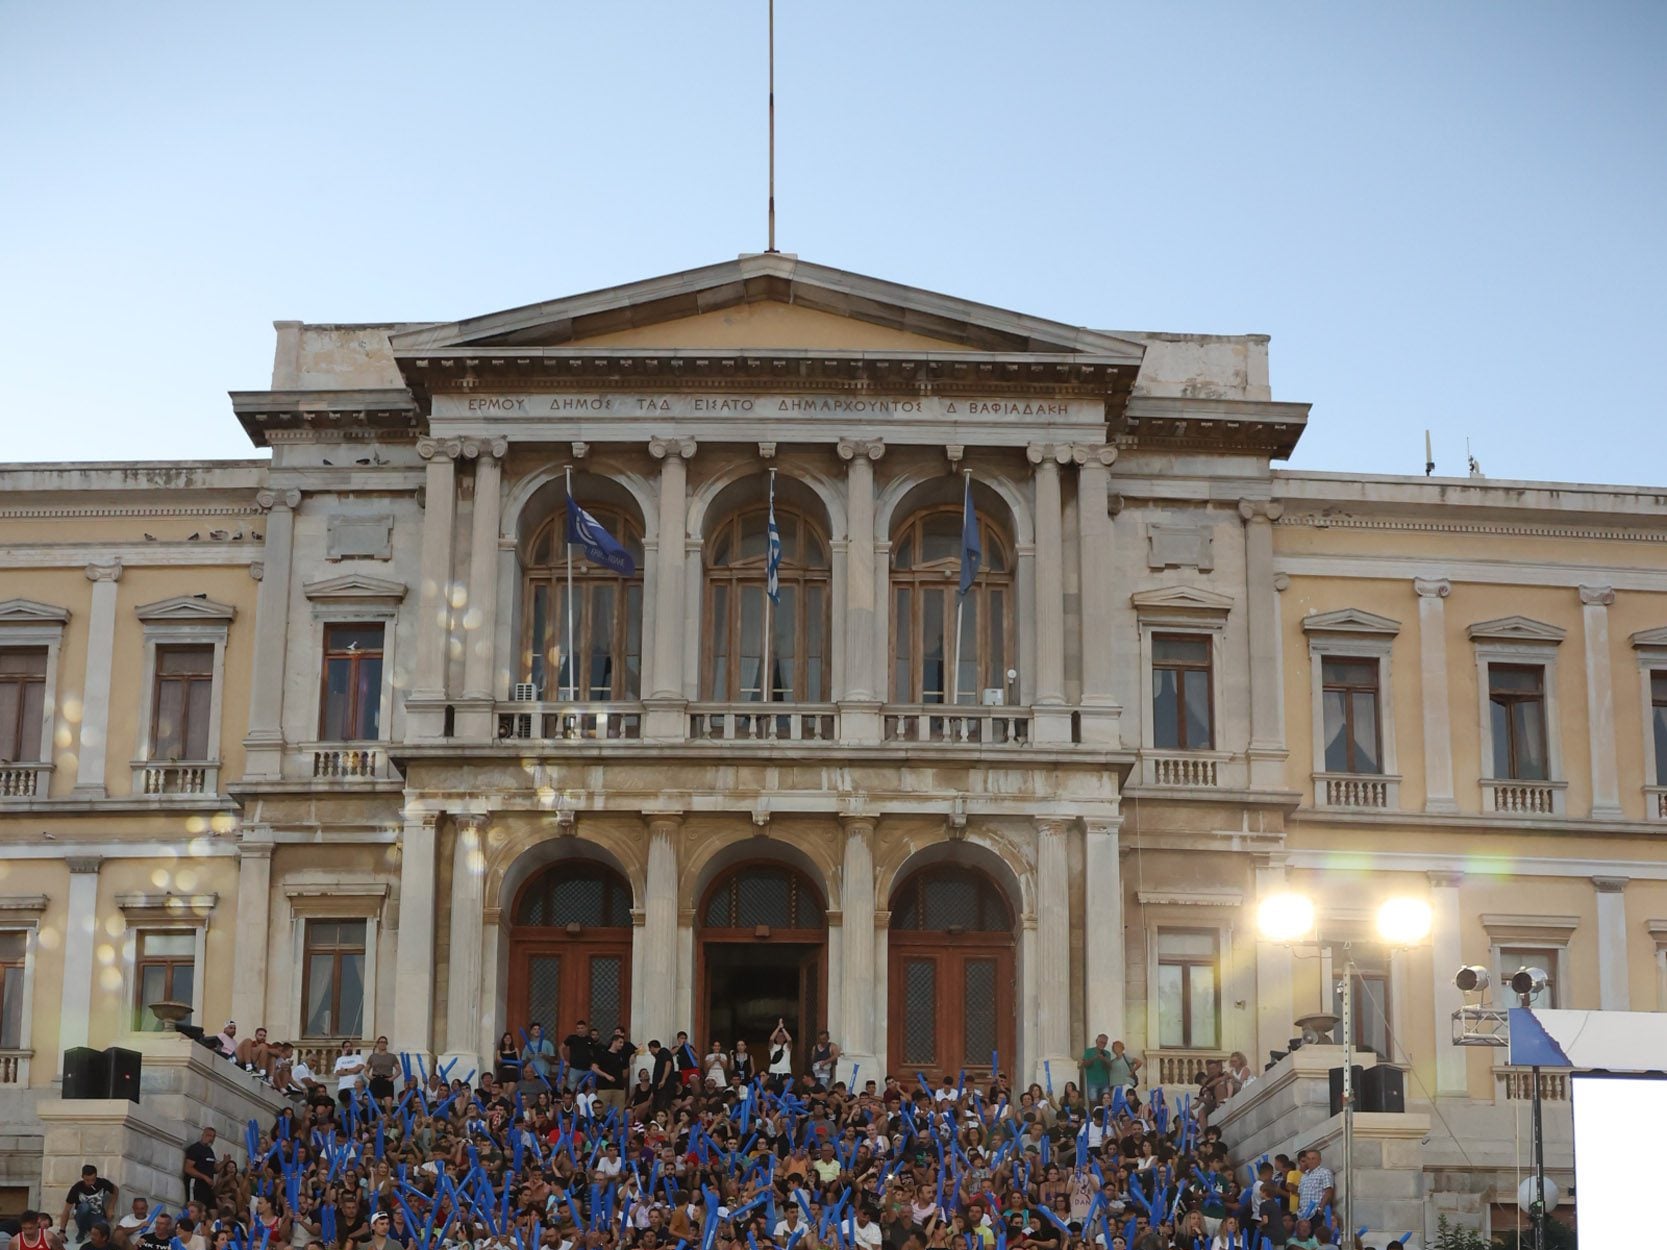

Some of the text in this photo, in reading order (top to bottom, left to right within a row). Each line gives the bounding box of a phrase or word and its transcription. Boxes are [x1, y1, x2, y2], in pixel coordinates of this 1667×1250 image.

[468, 398, 525, 411] ΕΡΜΟΥ
[550, 398, 611, 411] ΔΗΜΟΣ
[637, 399, 670, 410] ΤΑΔ
[778, 400, 922, 413] ΔΗΜΑΡΧΟΥΝΤΟΣ
[946, 402, 957, 413] Δ
[969, 402, 1068, 415] ΒΑΦΙΑΔΑΚΗ
